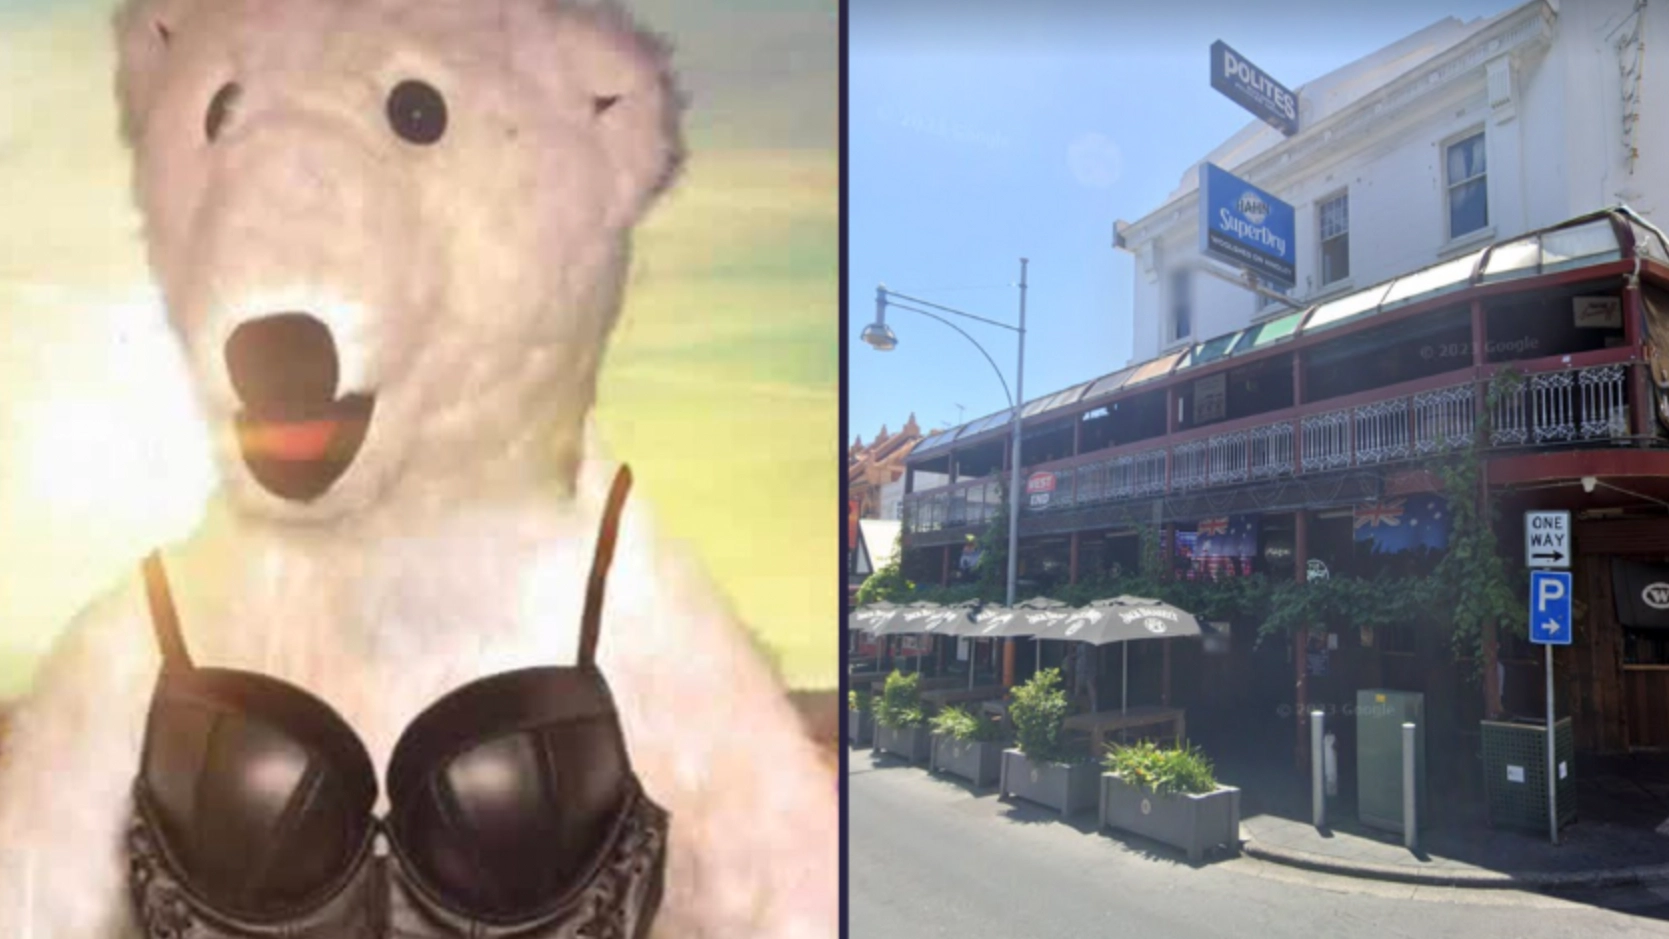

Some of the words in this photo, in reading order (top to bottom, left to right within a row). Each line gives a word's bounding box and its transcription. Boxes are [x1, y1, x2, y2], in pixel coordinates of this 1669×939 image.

[1223, 50, 1296, 120] POLITES
[1236, 198, 1270, 216] HAHN
[1219, 207, 1286, 257] SuperDry
[1028, 475, 1053, 490] WEST
[1030, 493, 1050, 507] END
[1532, 516, 1563, 530] ONE
[1530, 532, 1565, 547] WAY
[1538, 577, 1565, 611] P
